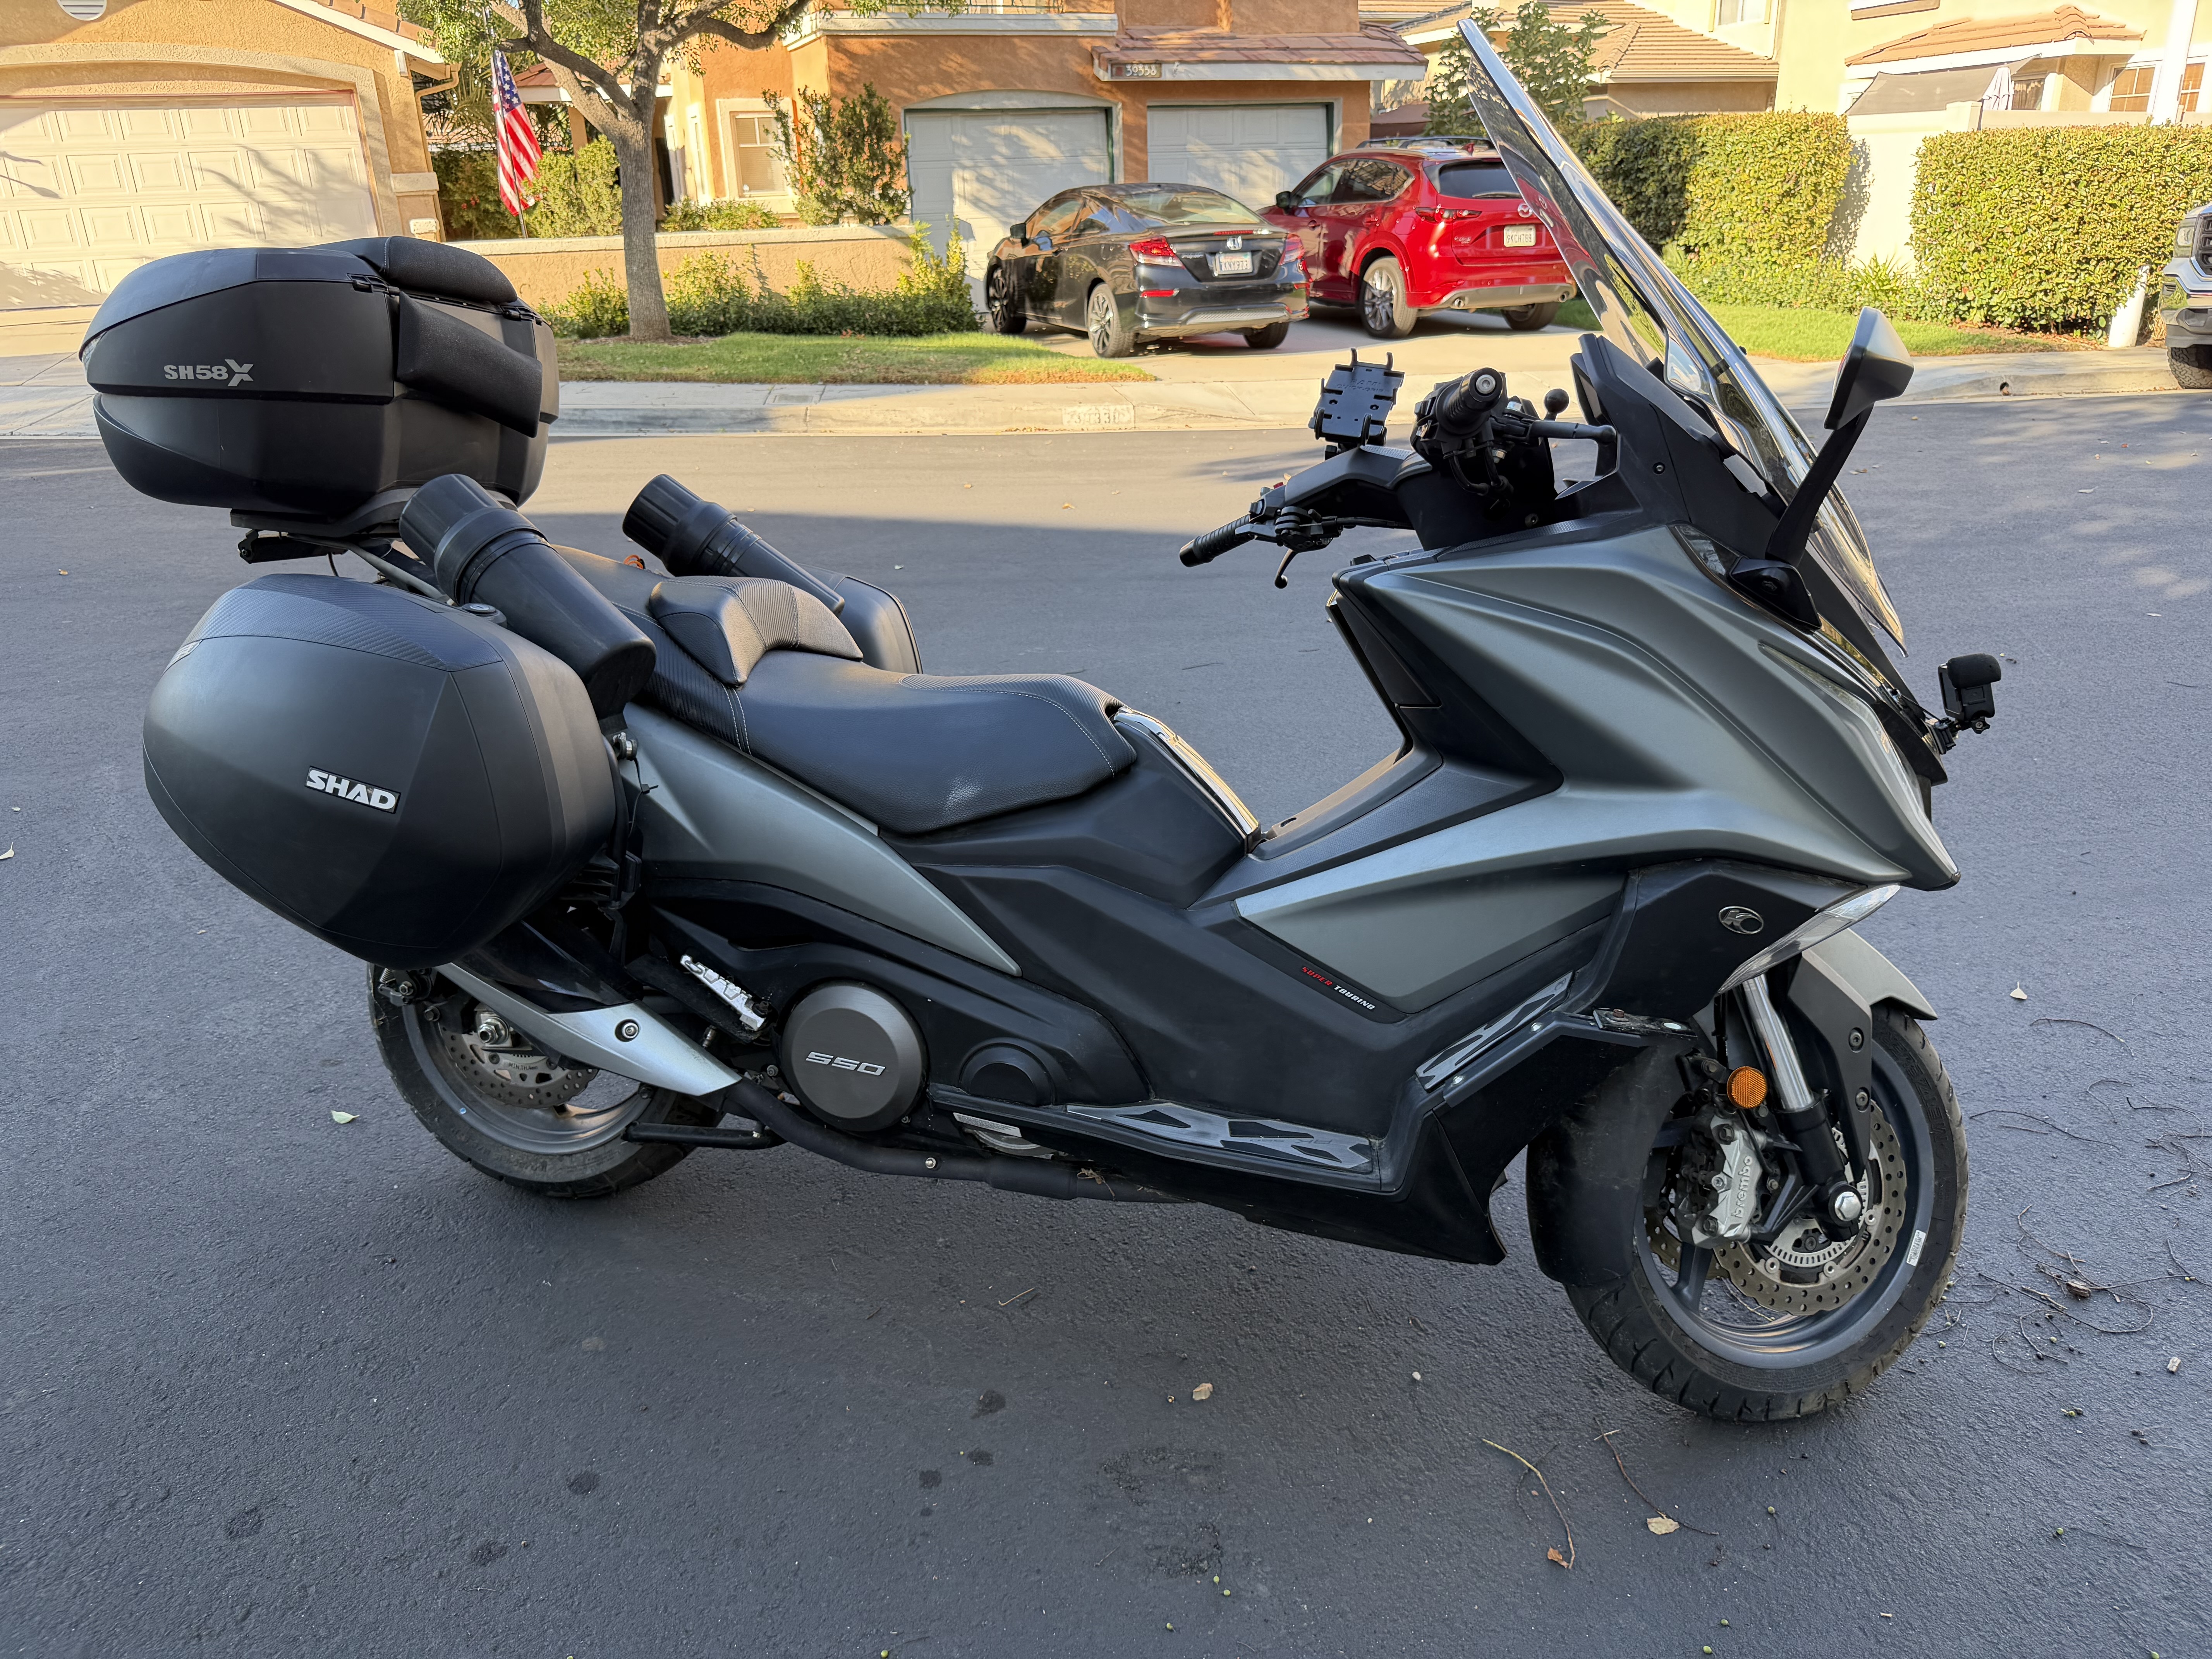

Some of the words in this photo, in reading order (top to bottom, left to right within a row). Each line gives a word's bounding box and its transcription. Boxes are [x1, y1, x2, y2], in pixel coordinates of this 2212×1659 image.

[164, 359, 254, 386] SH58X
[306, 769, 396, 809] SHAD
[1302, 967, 1333, 986] SUPER
[1334, 985, 1376, 1010] TOURING
[806, 1051, 886, 1076] 550
[1731, 1155, 1753, 1218] brembo
